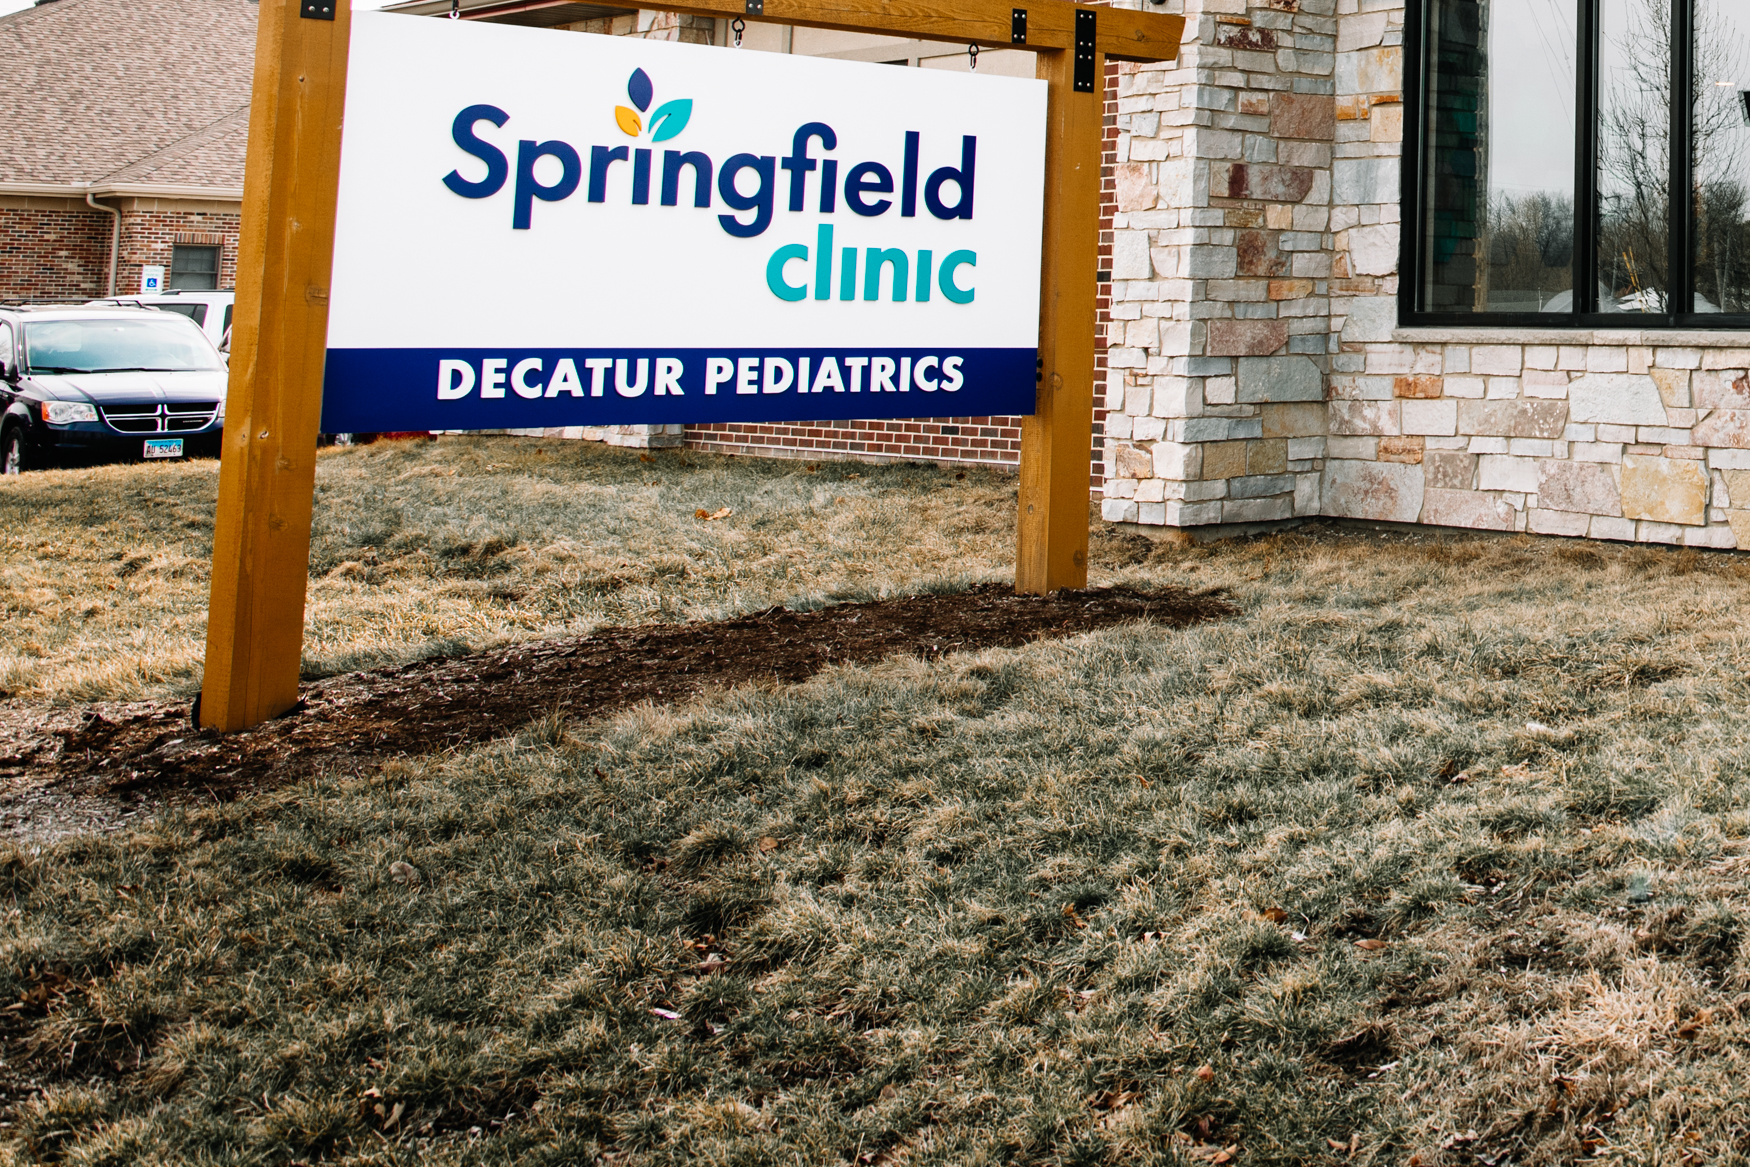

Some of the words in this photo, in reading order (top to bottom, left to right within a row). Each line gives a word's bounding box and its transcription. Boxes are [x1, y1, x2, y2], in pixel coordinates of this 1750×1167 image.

[441, 104, 977, 239] Springfield
[765, 223, 977, 305] clinic
[436, 357, 685, 400] DECATUR
[704, 355, 964, 395] PEDIATRICS
